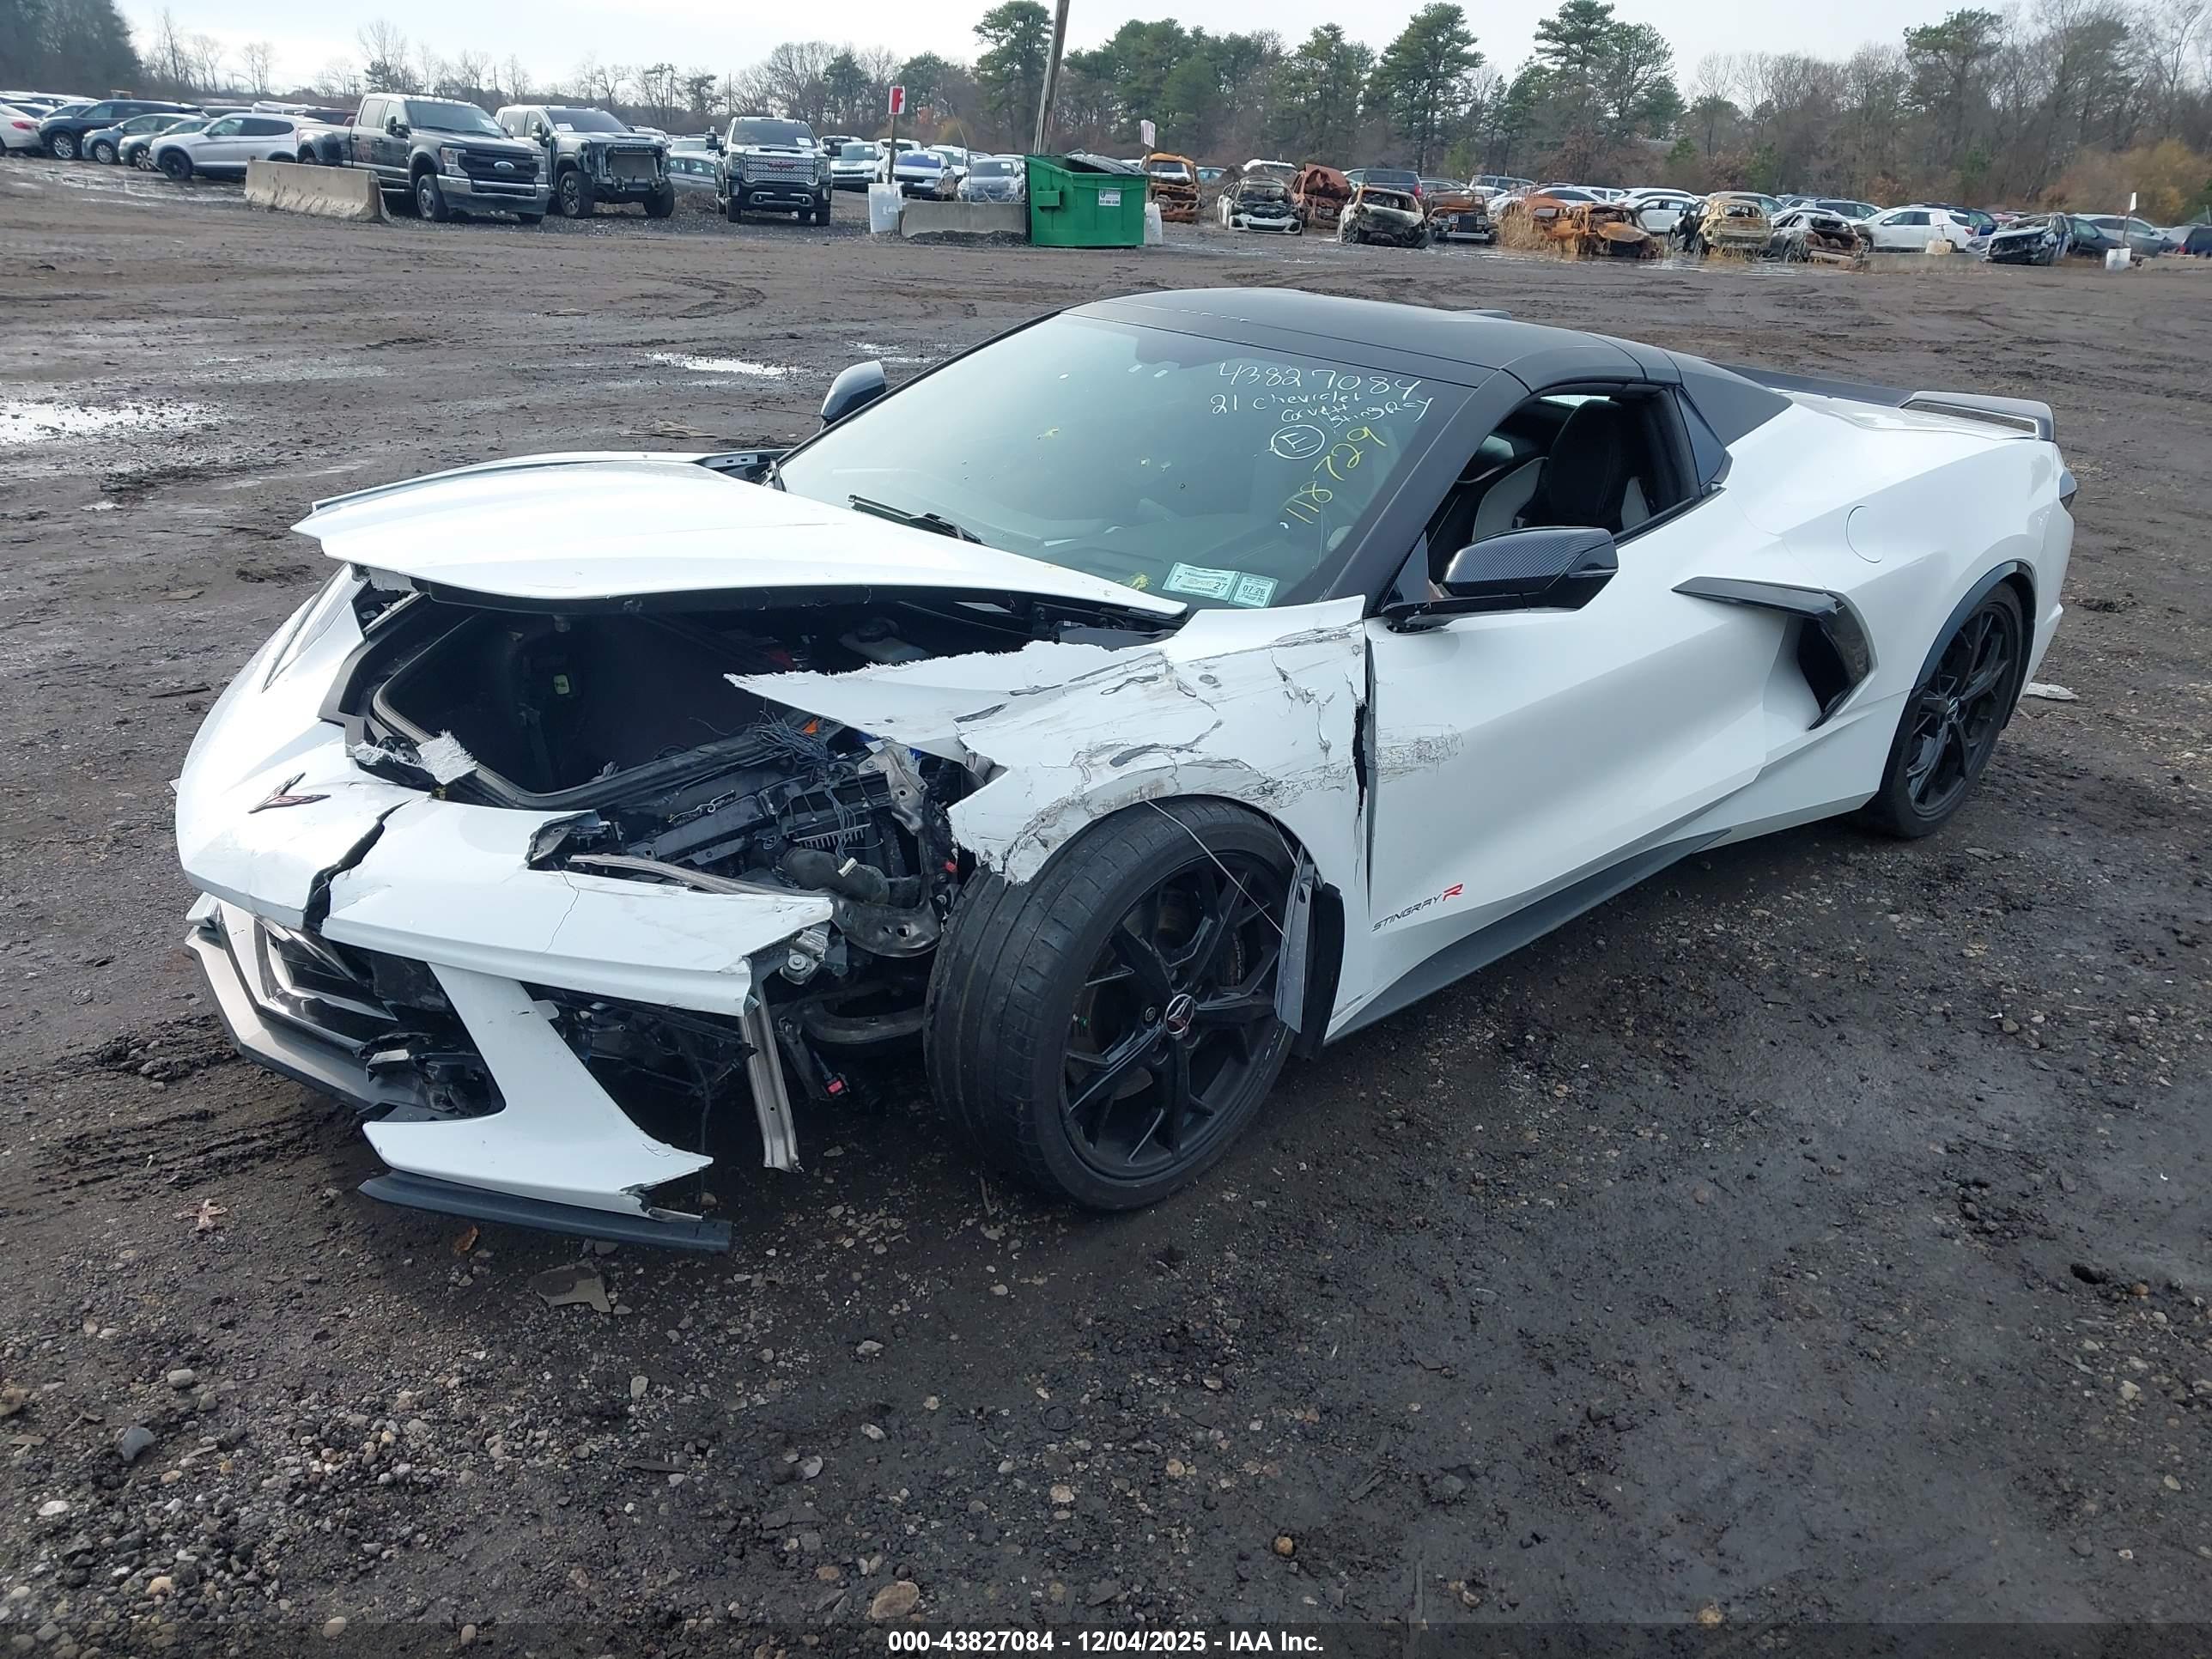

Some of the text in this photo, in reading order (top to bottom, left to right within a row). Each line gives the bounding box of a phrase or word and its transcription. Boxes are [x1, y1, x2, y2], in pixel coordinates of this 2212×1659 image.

[1210, 394, 1238, 414] 21
[1175, 574, 1182, 583] 7
[1212, 581, 1228, 591] 27
[1371, 884, 1464, 933] STINGRAY R
